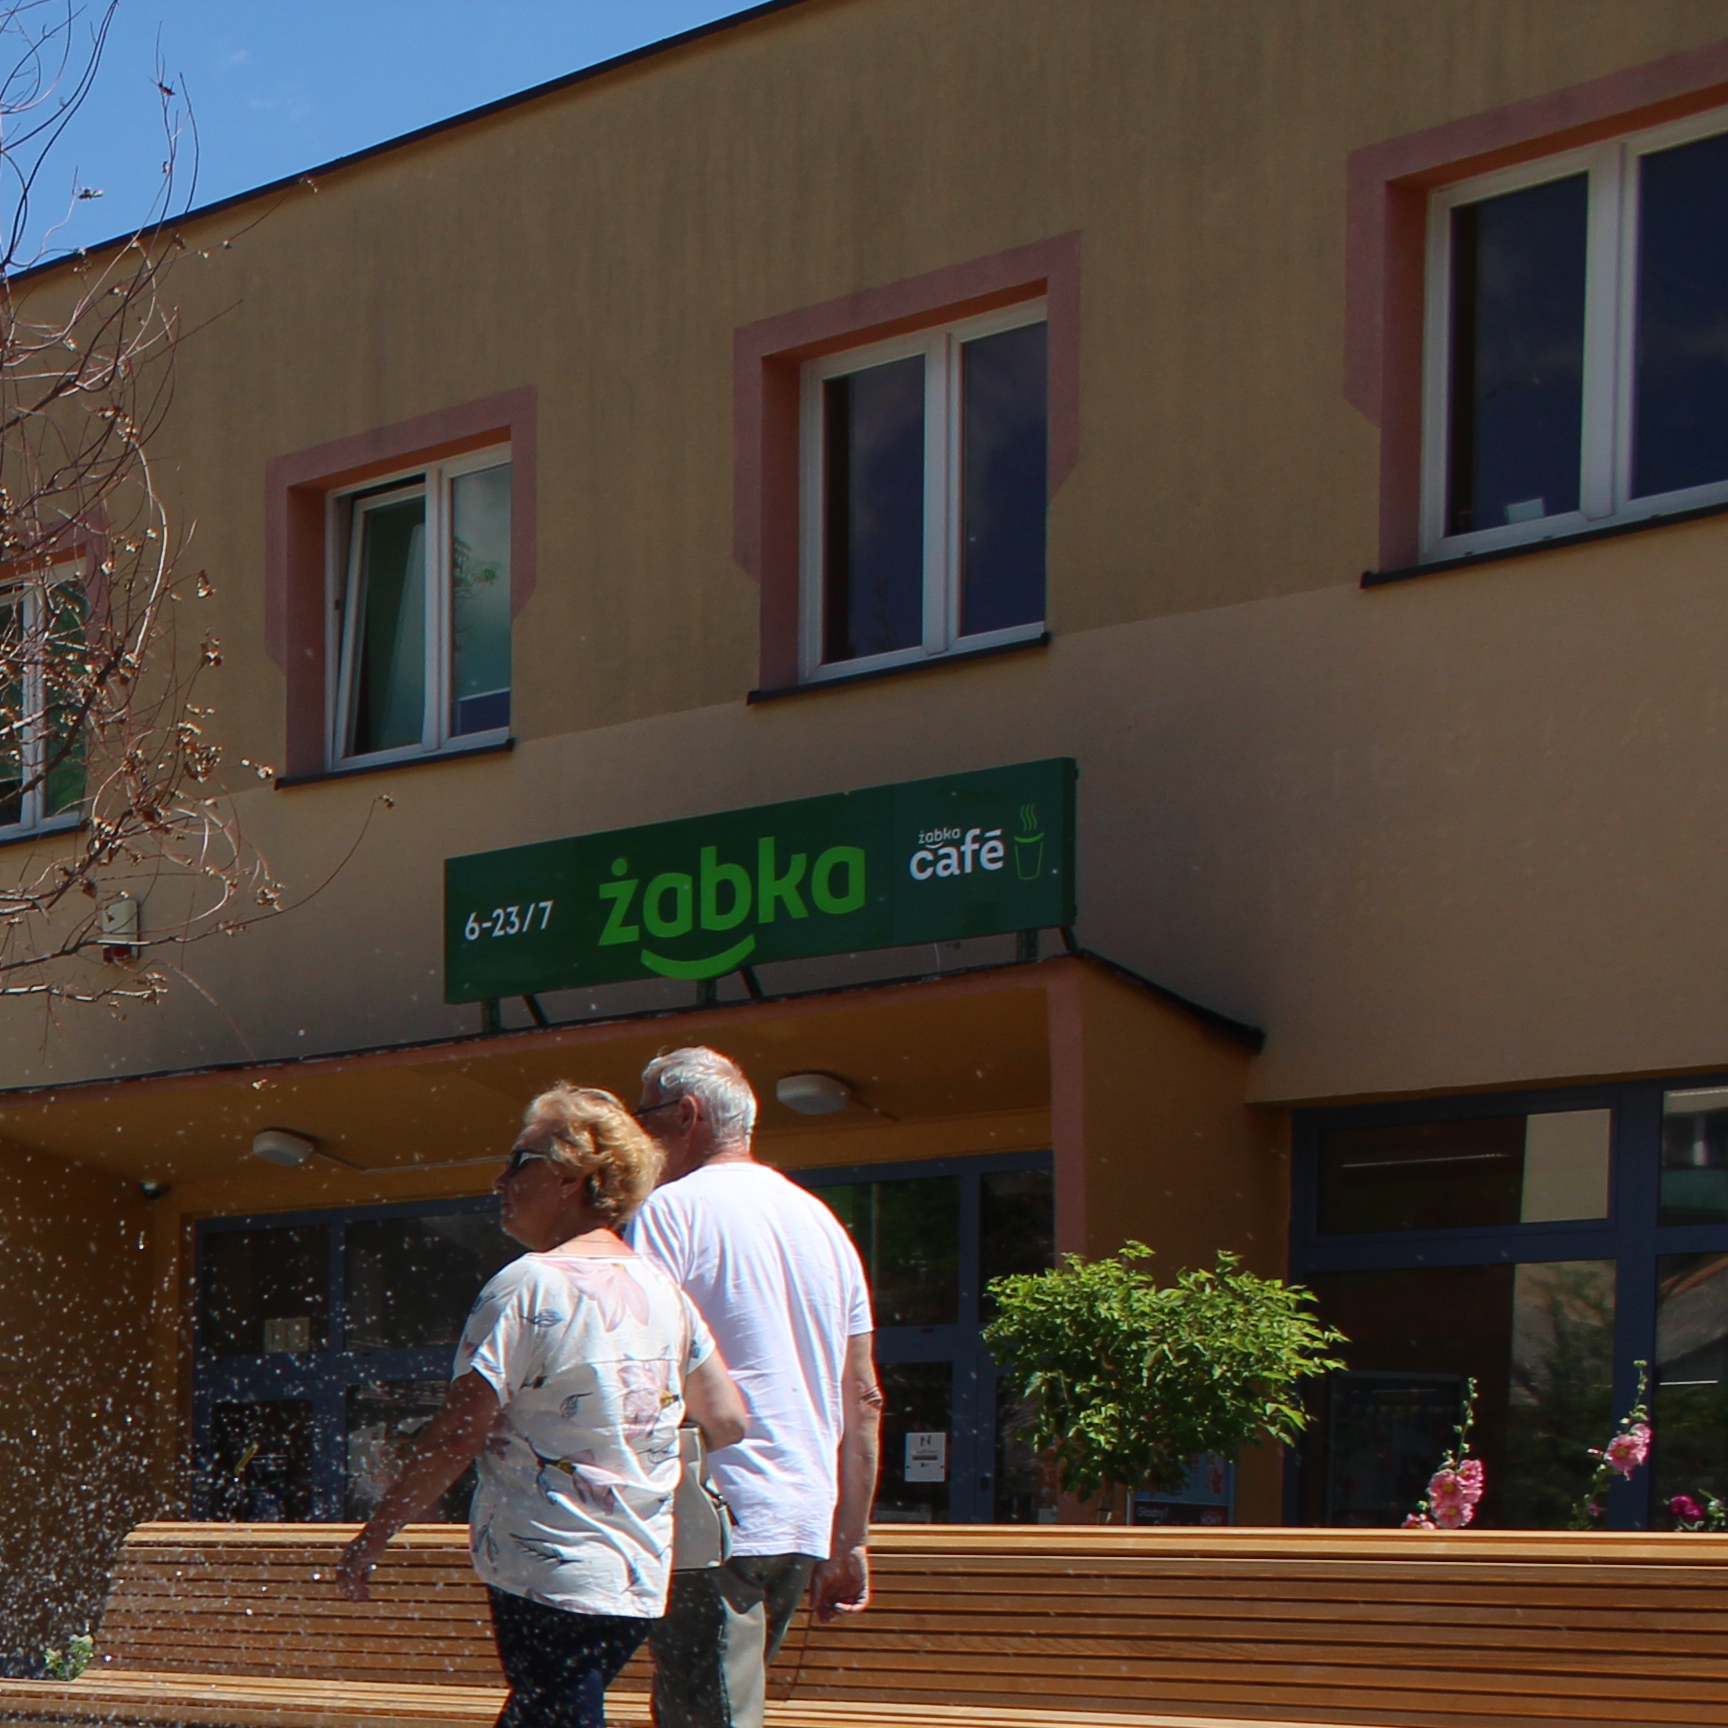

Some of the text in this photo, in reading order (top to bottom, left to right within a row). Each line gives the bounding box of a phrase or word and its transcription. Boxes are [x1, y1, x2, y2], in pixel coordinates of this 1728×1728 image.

[918, 827, 961, 844] żabka
[597, 836, 866, 947] żabka
[464, 900, 554, 941] 6-23/7
